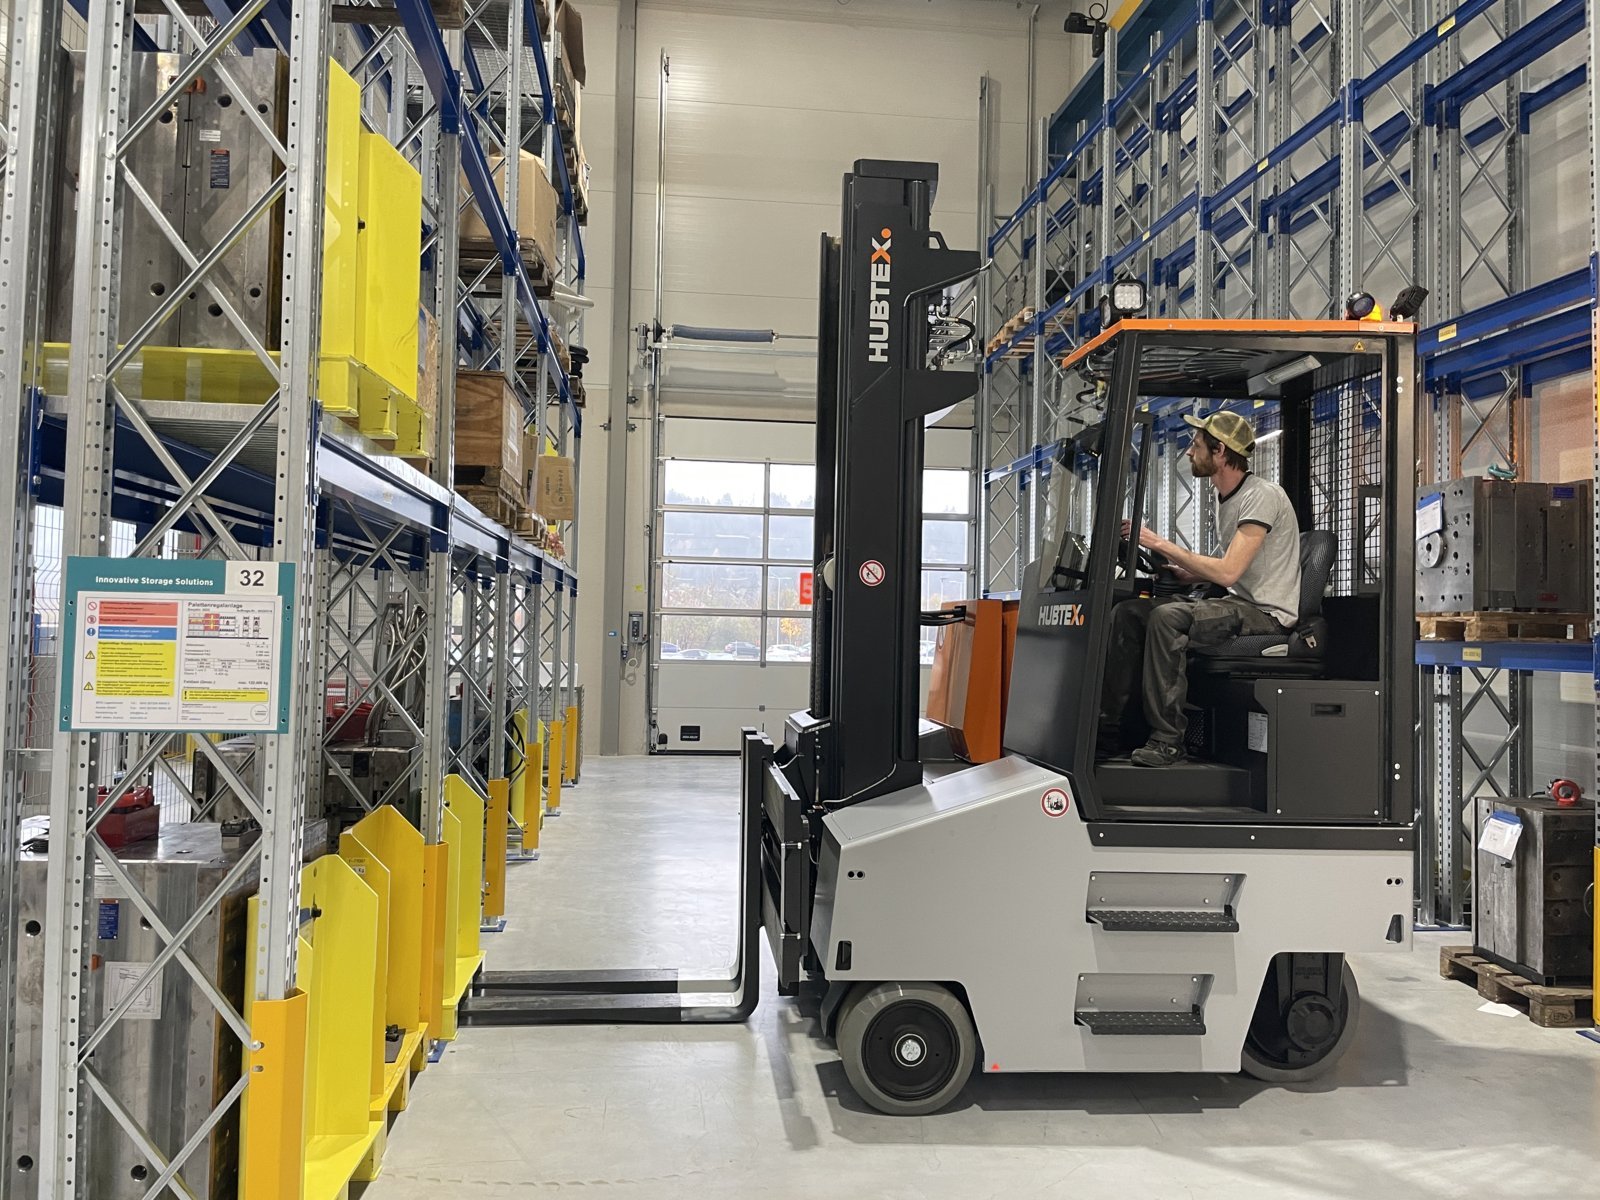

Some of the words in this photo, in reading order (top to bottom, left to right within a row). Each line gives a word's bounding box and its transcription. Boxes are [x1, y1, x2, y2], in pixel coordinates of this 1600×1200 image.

[95, 575, 139, 584] Innovative
[141, 576, 173, 586] Storage
[175, 577, 214, 586] Solutions
[240, 569, 264, 587] 32
